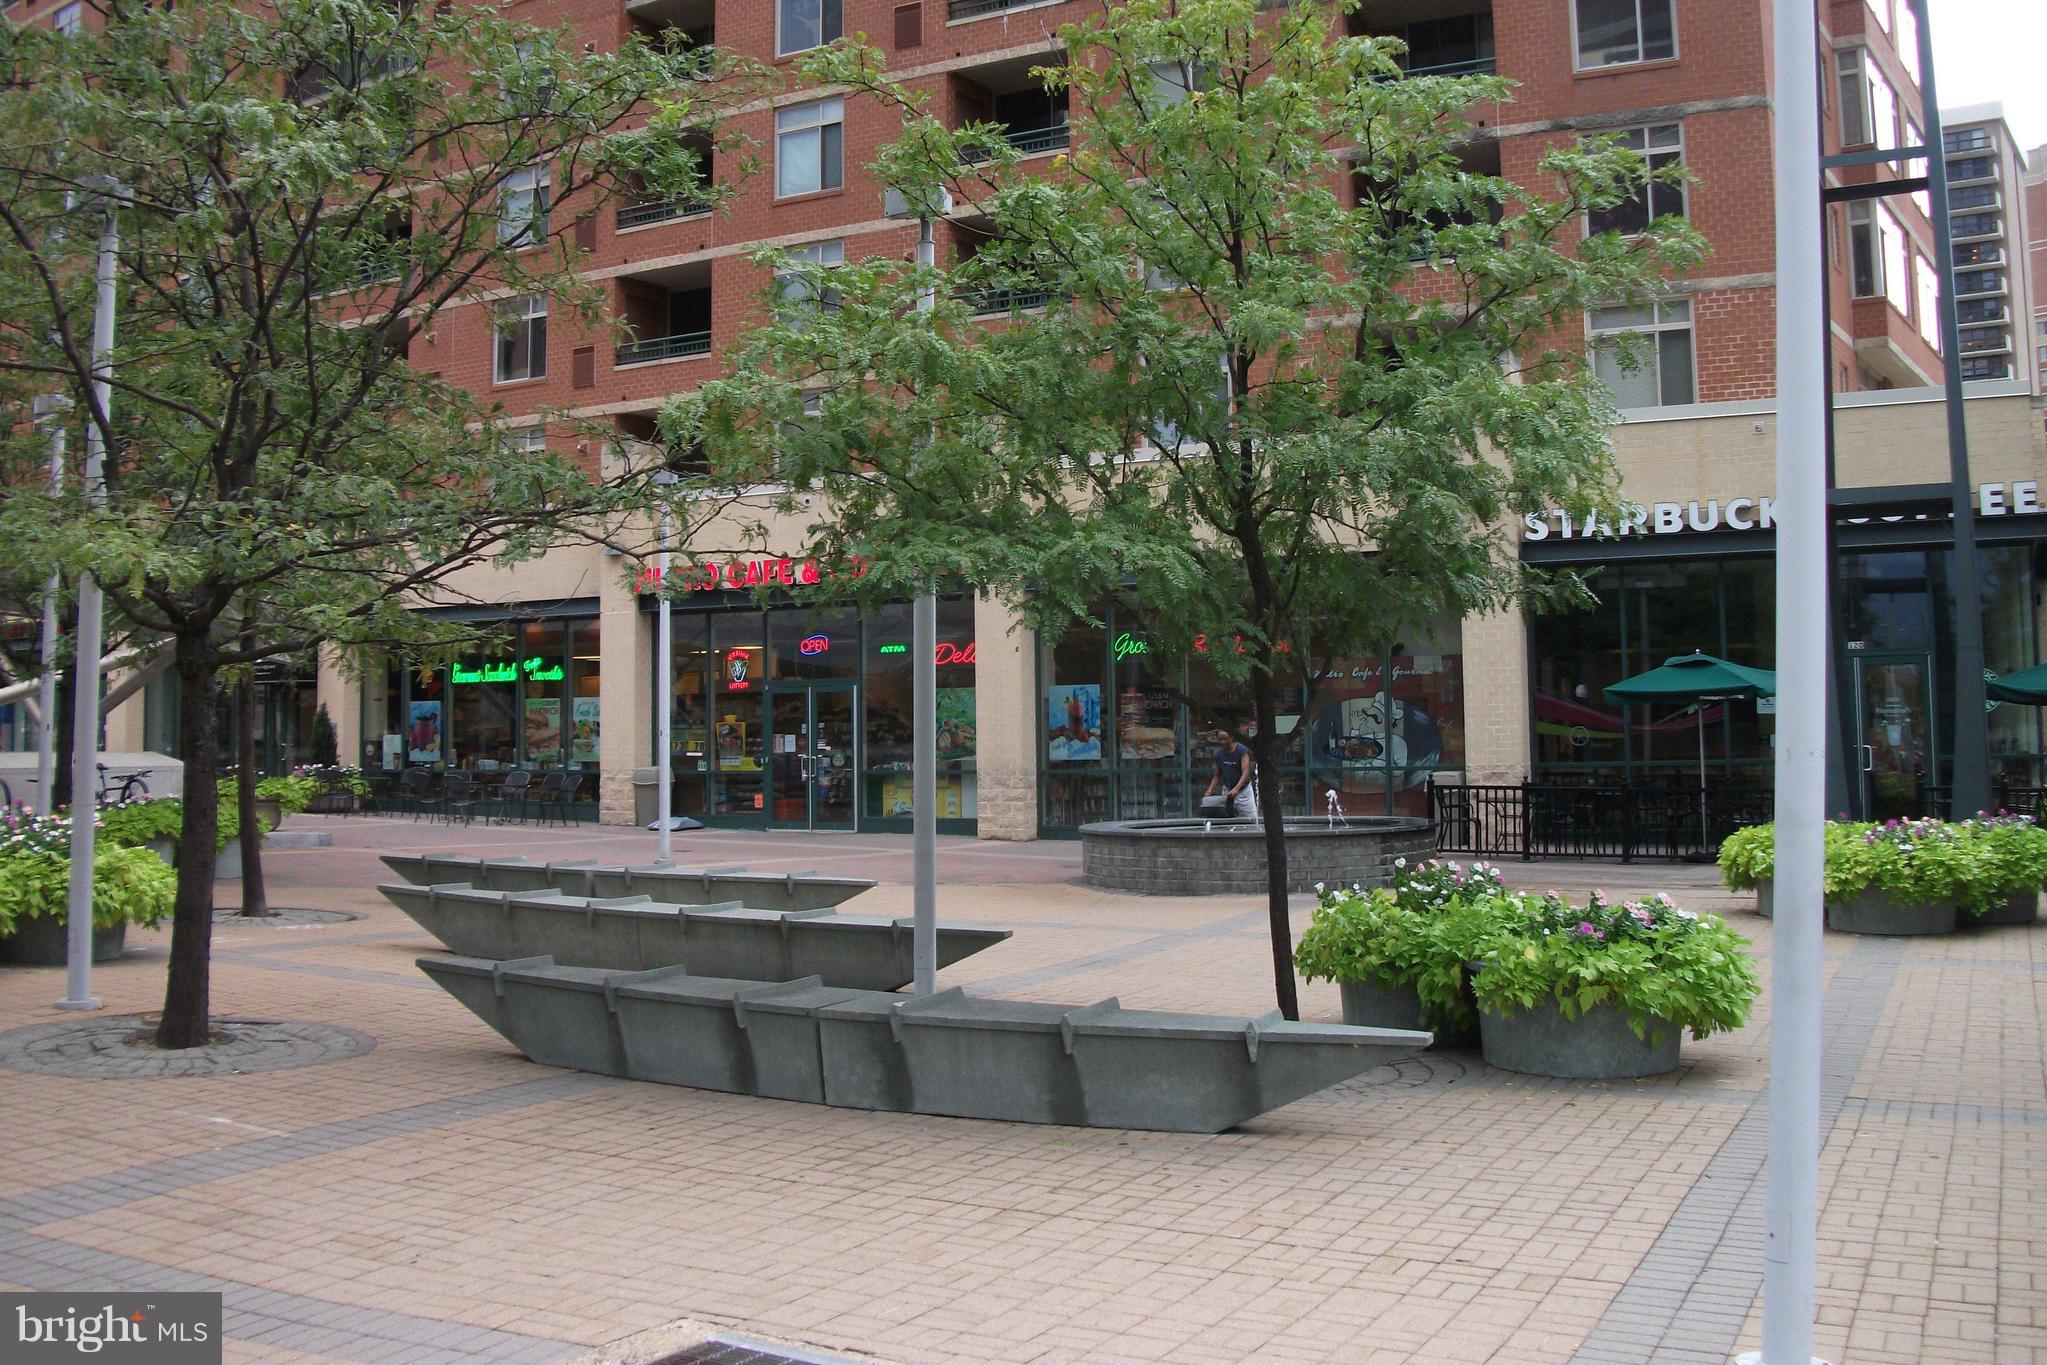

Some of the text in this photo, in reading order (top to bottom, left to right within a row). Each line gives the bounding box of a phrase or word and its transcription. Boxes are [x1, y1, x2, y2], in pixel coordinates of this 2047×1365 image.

[1524, 497, 1777, 541] STARBUCK
[801, 639, 829, 653] OPEN
[880, 645, 906, 653] ATM
